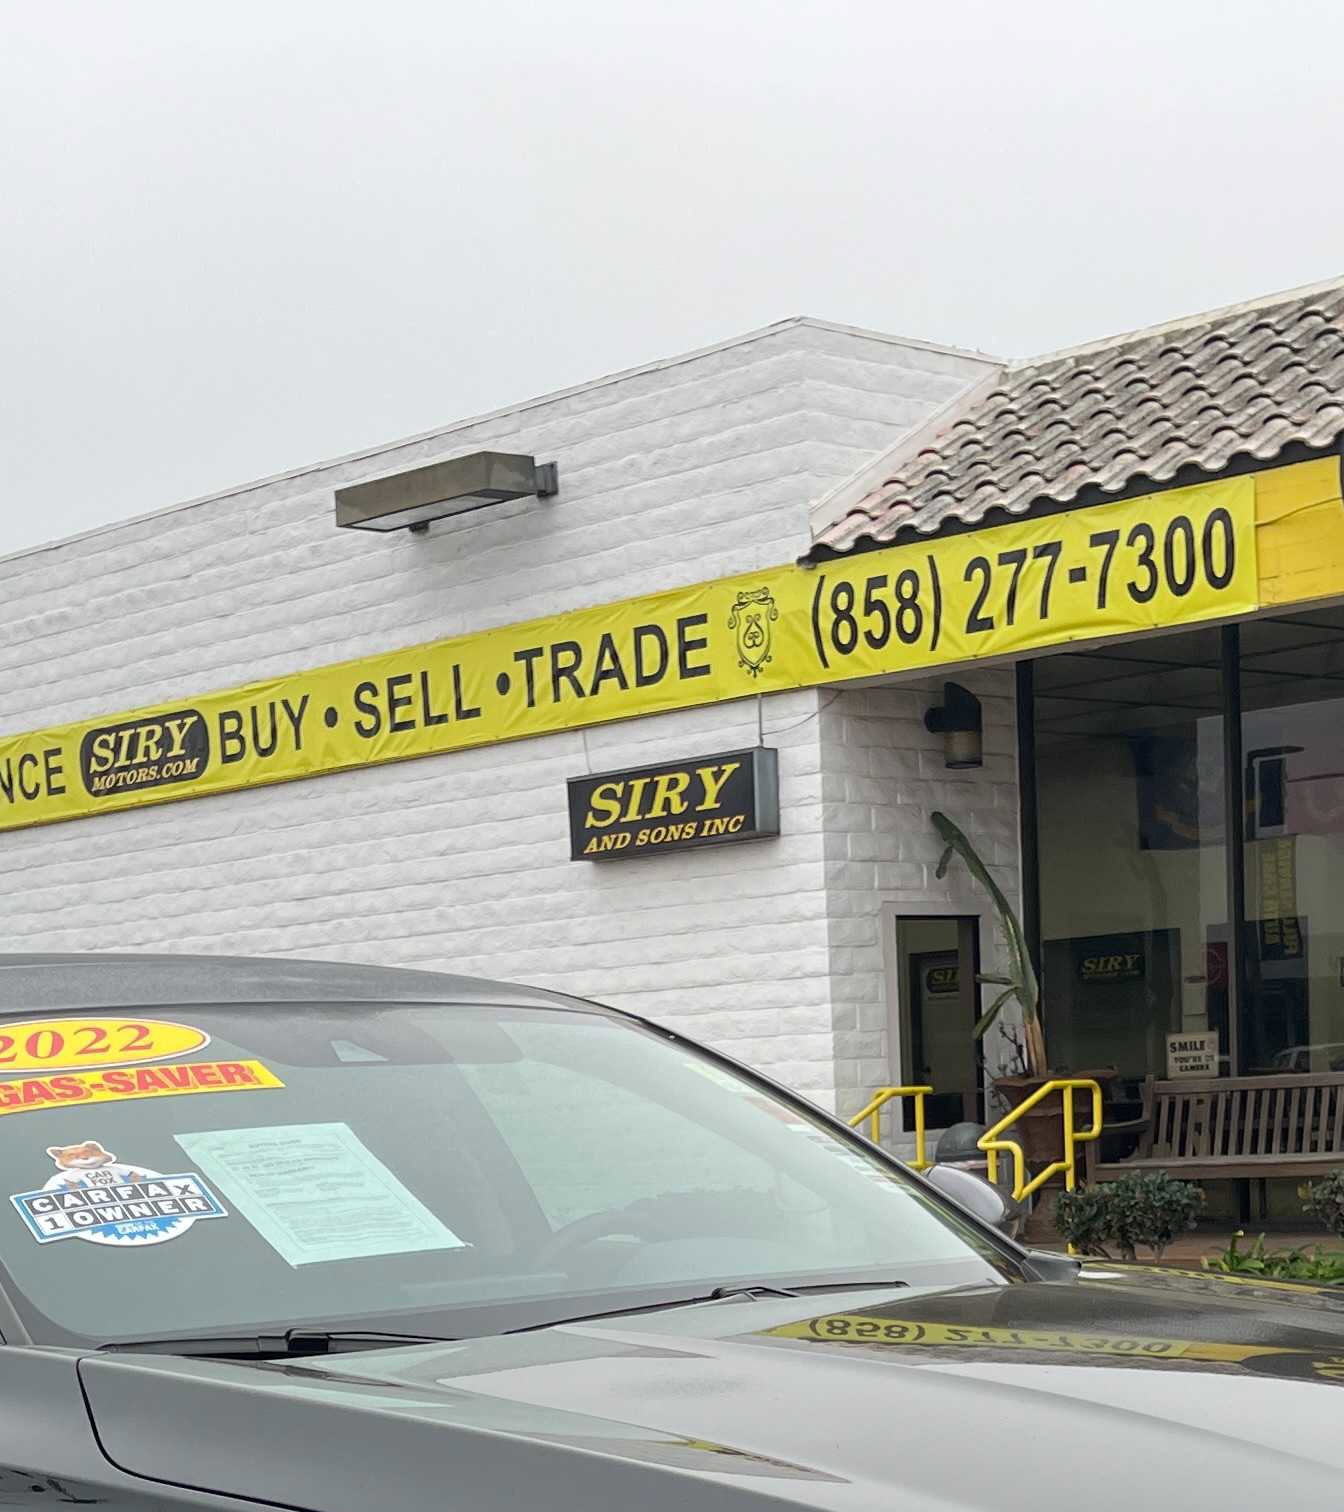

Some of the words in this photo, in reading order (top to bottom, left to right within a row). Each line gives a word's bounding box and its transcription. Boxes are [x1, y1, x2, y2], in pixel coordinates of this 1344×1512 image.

[812, 556, 942, 669] (858)
[964, 507, 1235, 634] 277-7300
[220, 695, 309, 764] BUY
[354, 664, 481, 738] SELL
[514, 614, 711, 709] TRADE
[89, 717, 197, 775] SIRY
[92, 757, 199, 792] MOTORS.COM
[584, 762, 741, 828] SIRY
[584, 830, 630, 854] AND
[636, 822, 697, 849] SONS
[702, 814, 745, 837] INC
[1169, 1040, 1206, 1053] SMILE
[84, 1170, 113, 1181] CAR
[90, 1178, 119, 1187] FOX
[30, 1182, 197, 1213] CARFAX
[72, 1198, 208, 1226] OWNER
